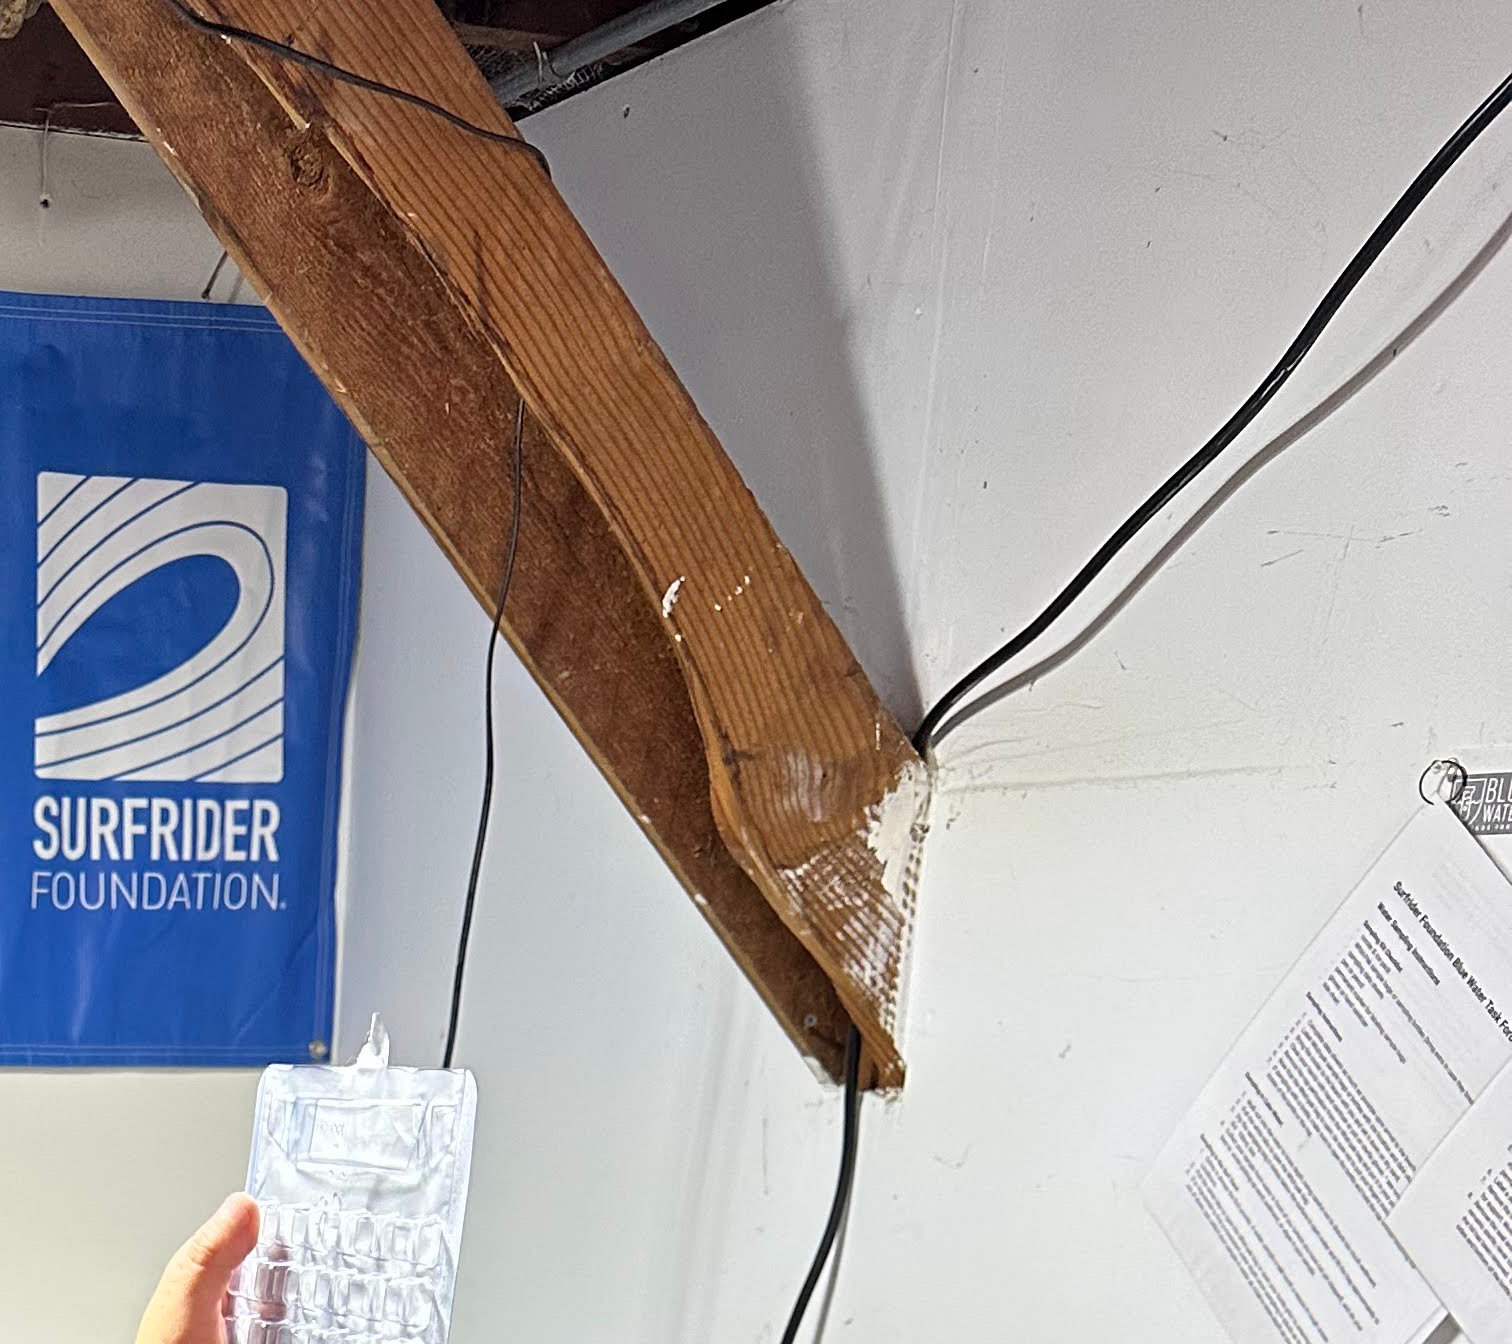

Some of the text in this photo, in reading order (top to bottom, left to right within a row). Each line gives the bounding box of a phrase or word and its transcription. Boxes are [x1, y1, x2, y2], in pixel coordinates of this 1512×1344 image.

[32, 795, 281, 862] SURFRIDER
[1393, 881, 1422, 918] Surfrider
[1419, 914, 1455, 961] Foundation
[1451, 957, 1469, 980] Blue
[1466, 975, 1488, 1003] Water
[1485, 999, 1502, 1024] Task
